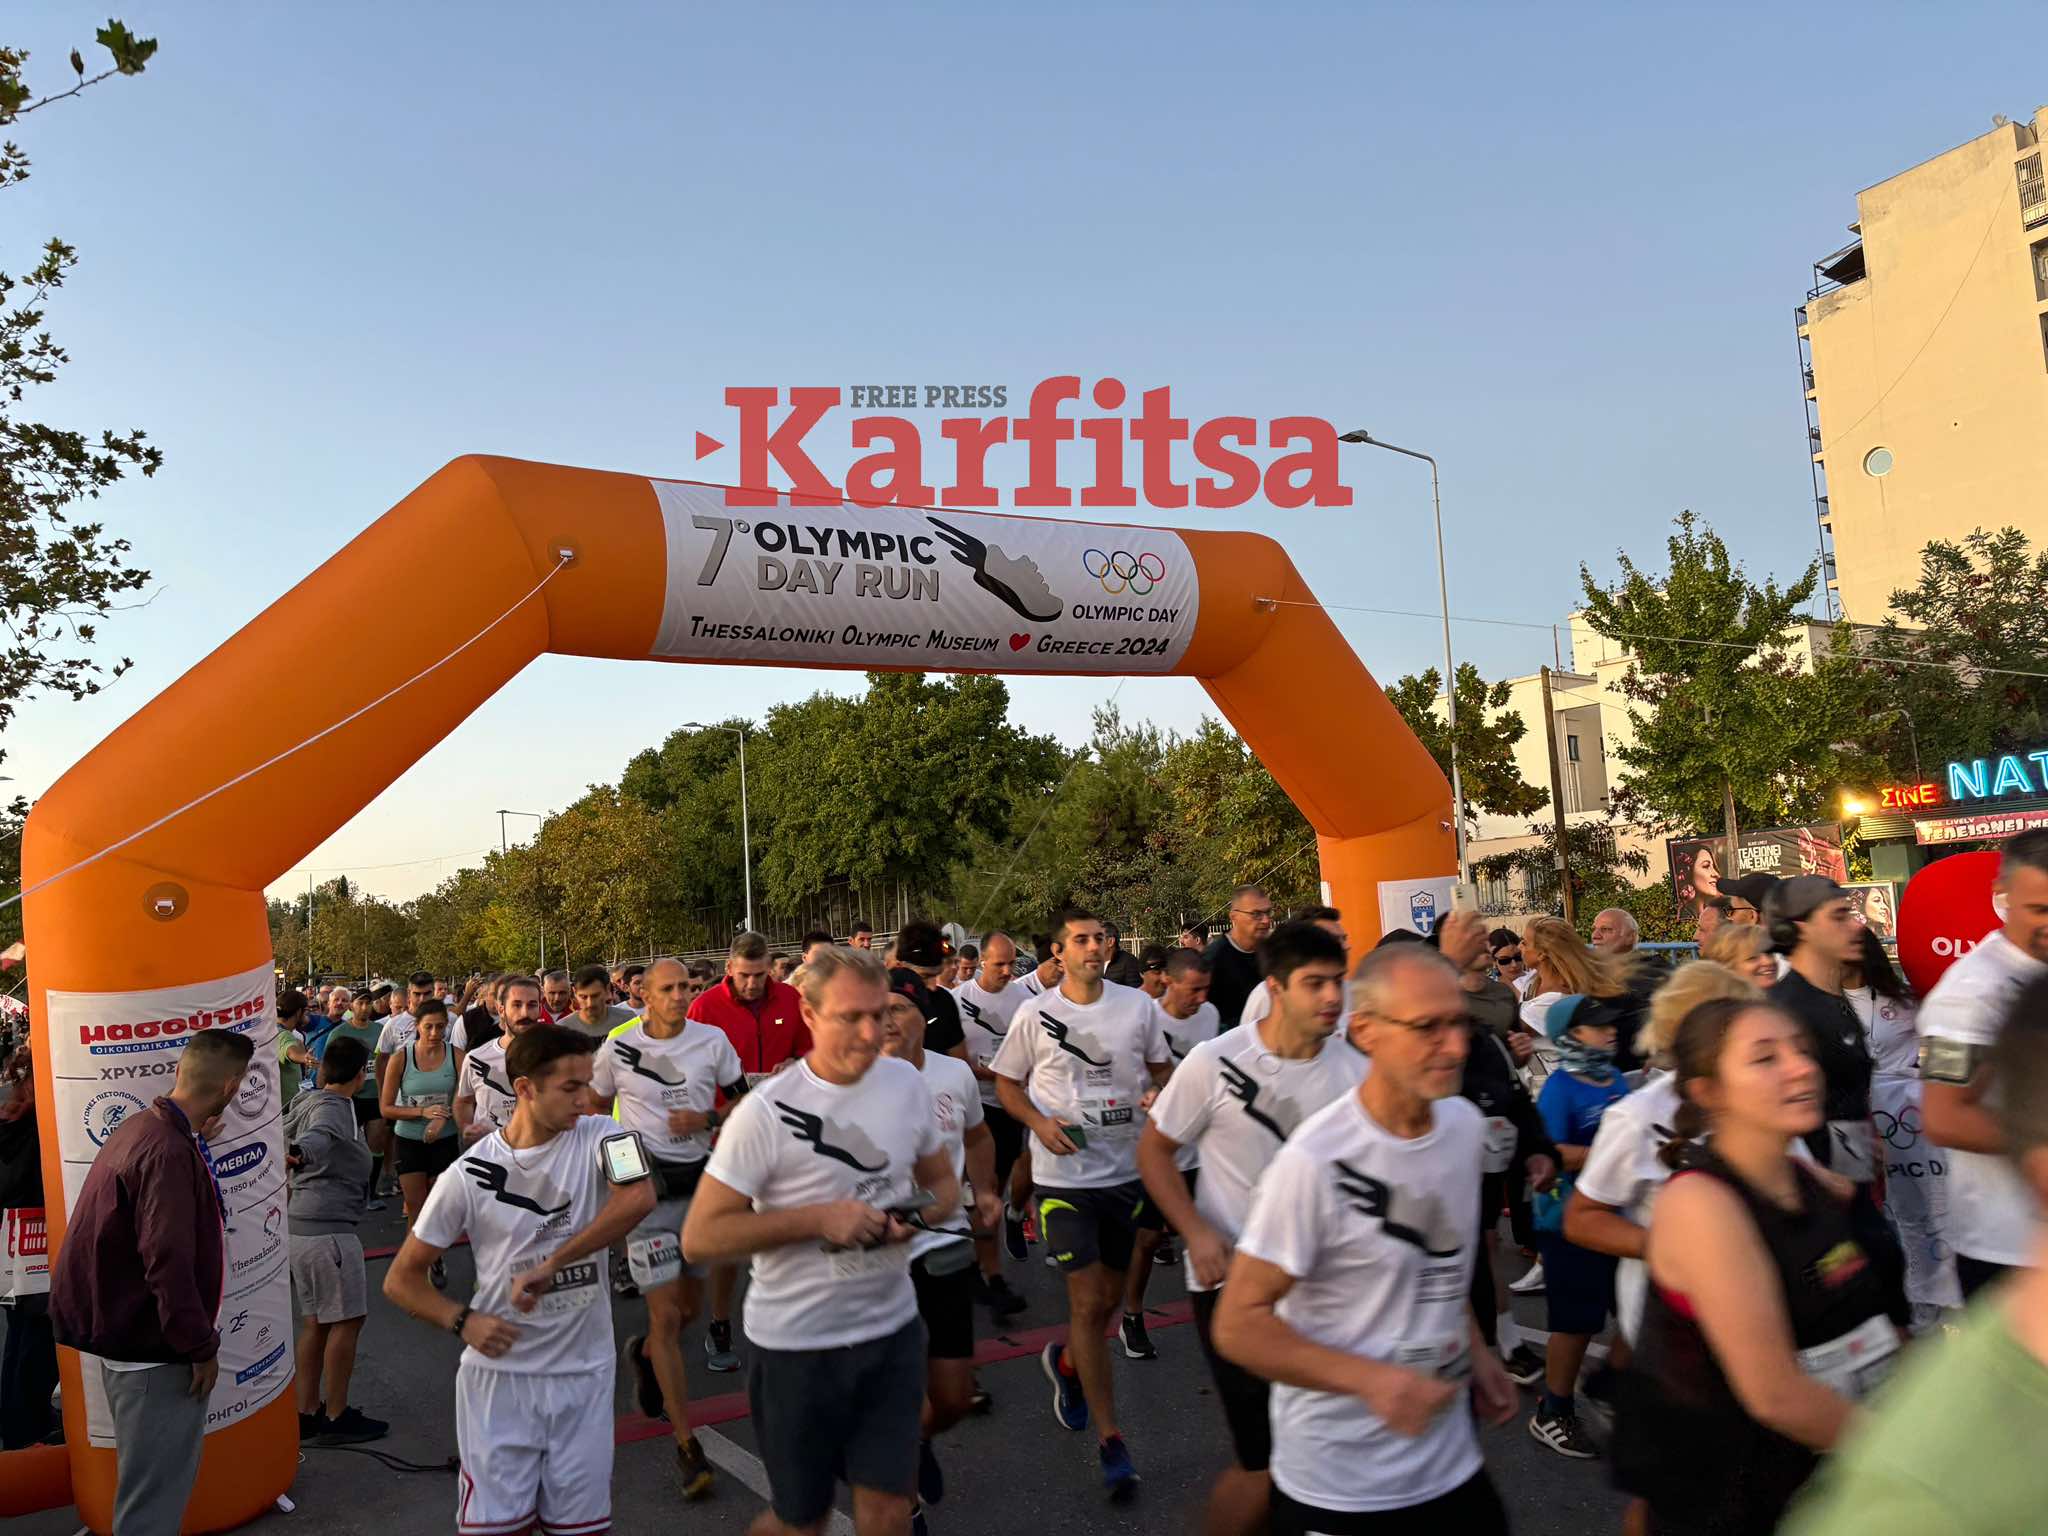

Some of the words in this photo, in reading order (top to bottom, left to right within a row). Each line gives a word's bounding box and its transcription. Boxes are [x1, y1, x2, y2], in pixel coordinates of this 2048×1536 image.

[753, 521, 938, 565] OLYMPIC
[756, 555, 844, 595] DAY
[854, 563, 940, 602] RUN
[1071, 604, 1144, 623] OLYMPIC
[1148, 607, 1179, 624] DAY
[1114, 637, 1171, 656] 2024
[79, 995, 265, 1045] μασούτης
[96, 1040, 170, 1054] ΟΙΚΟΝΟΜΙΚΑ
[215, 1147, 263, 1175] ΜΕΒΓΑΛ
[551, 1265, 592, 1285] 0159
[207, 1400, 248, 1424] ΡΗΓΟΙ
